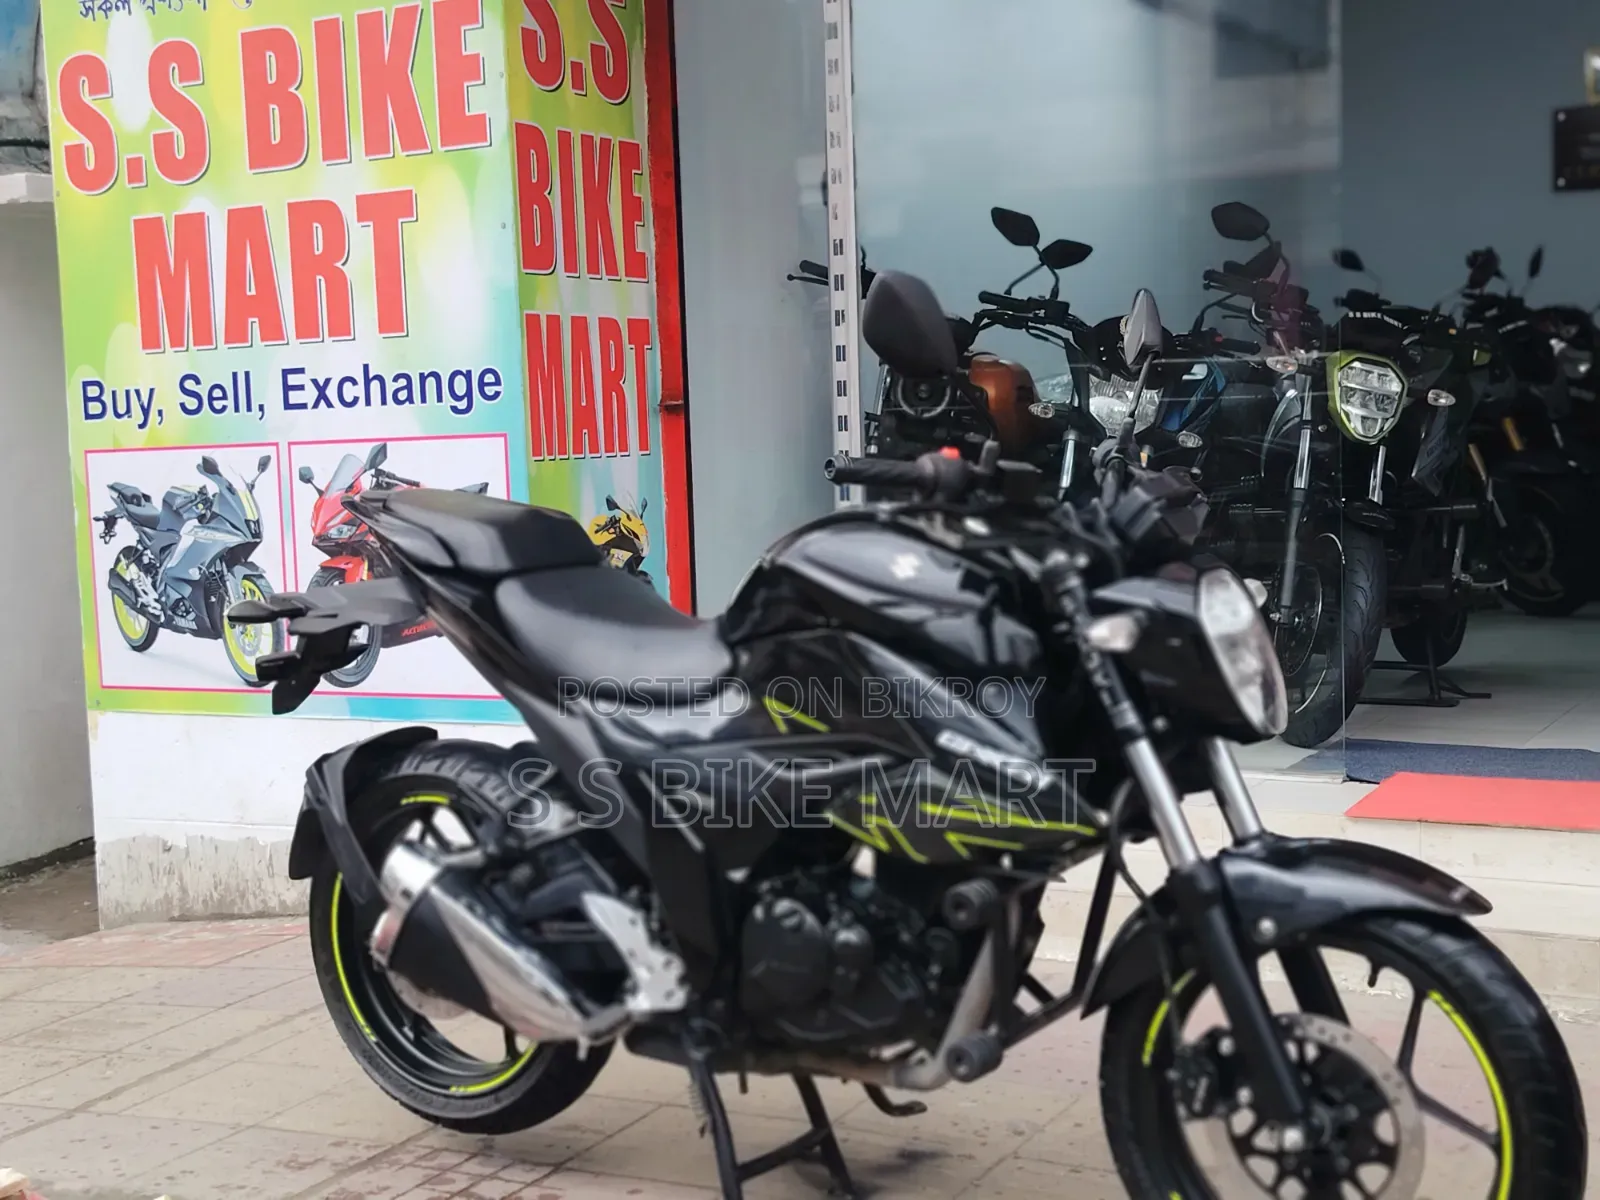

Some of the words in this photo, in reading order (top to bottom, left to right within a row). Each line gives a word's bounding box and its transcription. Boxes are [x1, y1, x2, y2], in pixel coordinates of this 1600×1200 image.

[59, 39, 209, 193] S.S
[240, 0, 490, 173] BIKE
[520, 0, 630, 103] S.S
[132, 189, 417, 353] MART
[514, 121, 649, 281] BIKE
[82, 379, 164, 430] Buy,
[179, 370, 266, 420] Sell,
[281, 363, 502, 415] Exchange
[524, 312, 651, 460] MART
